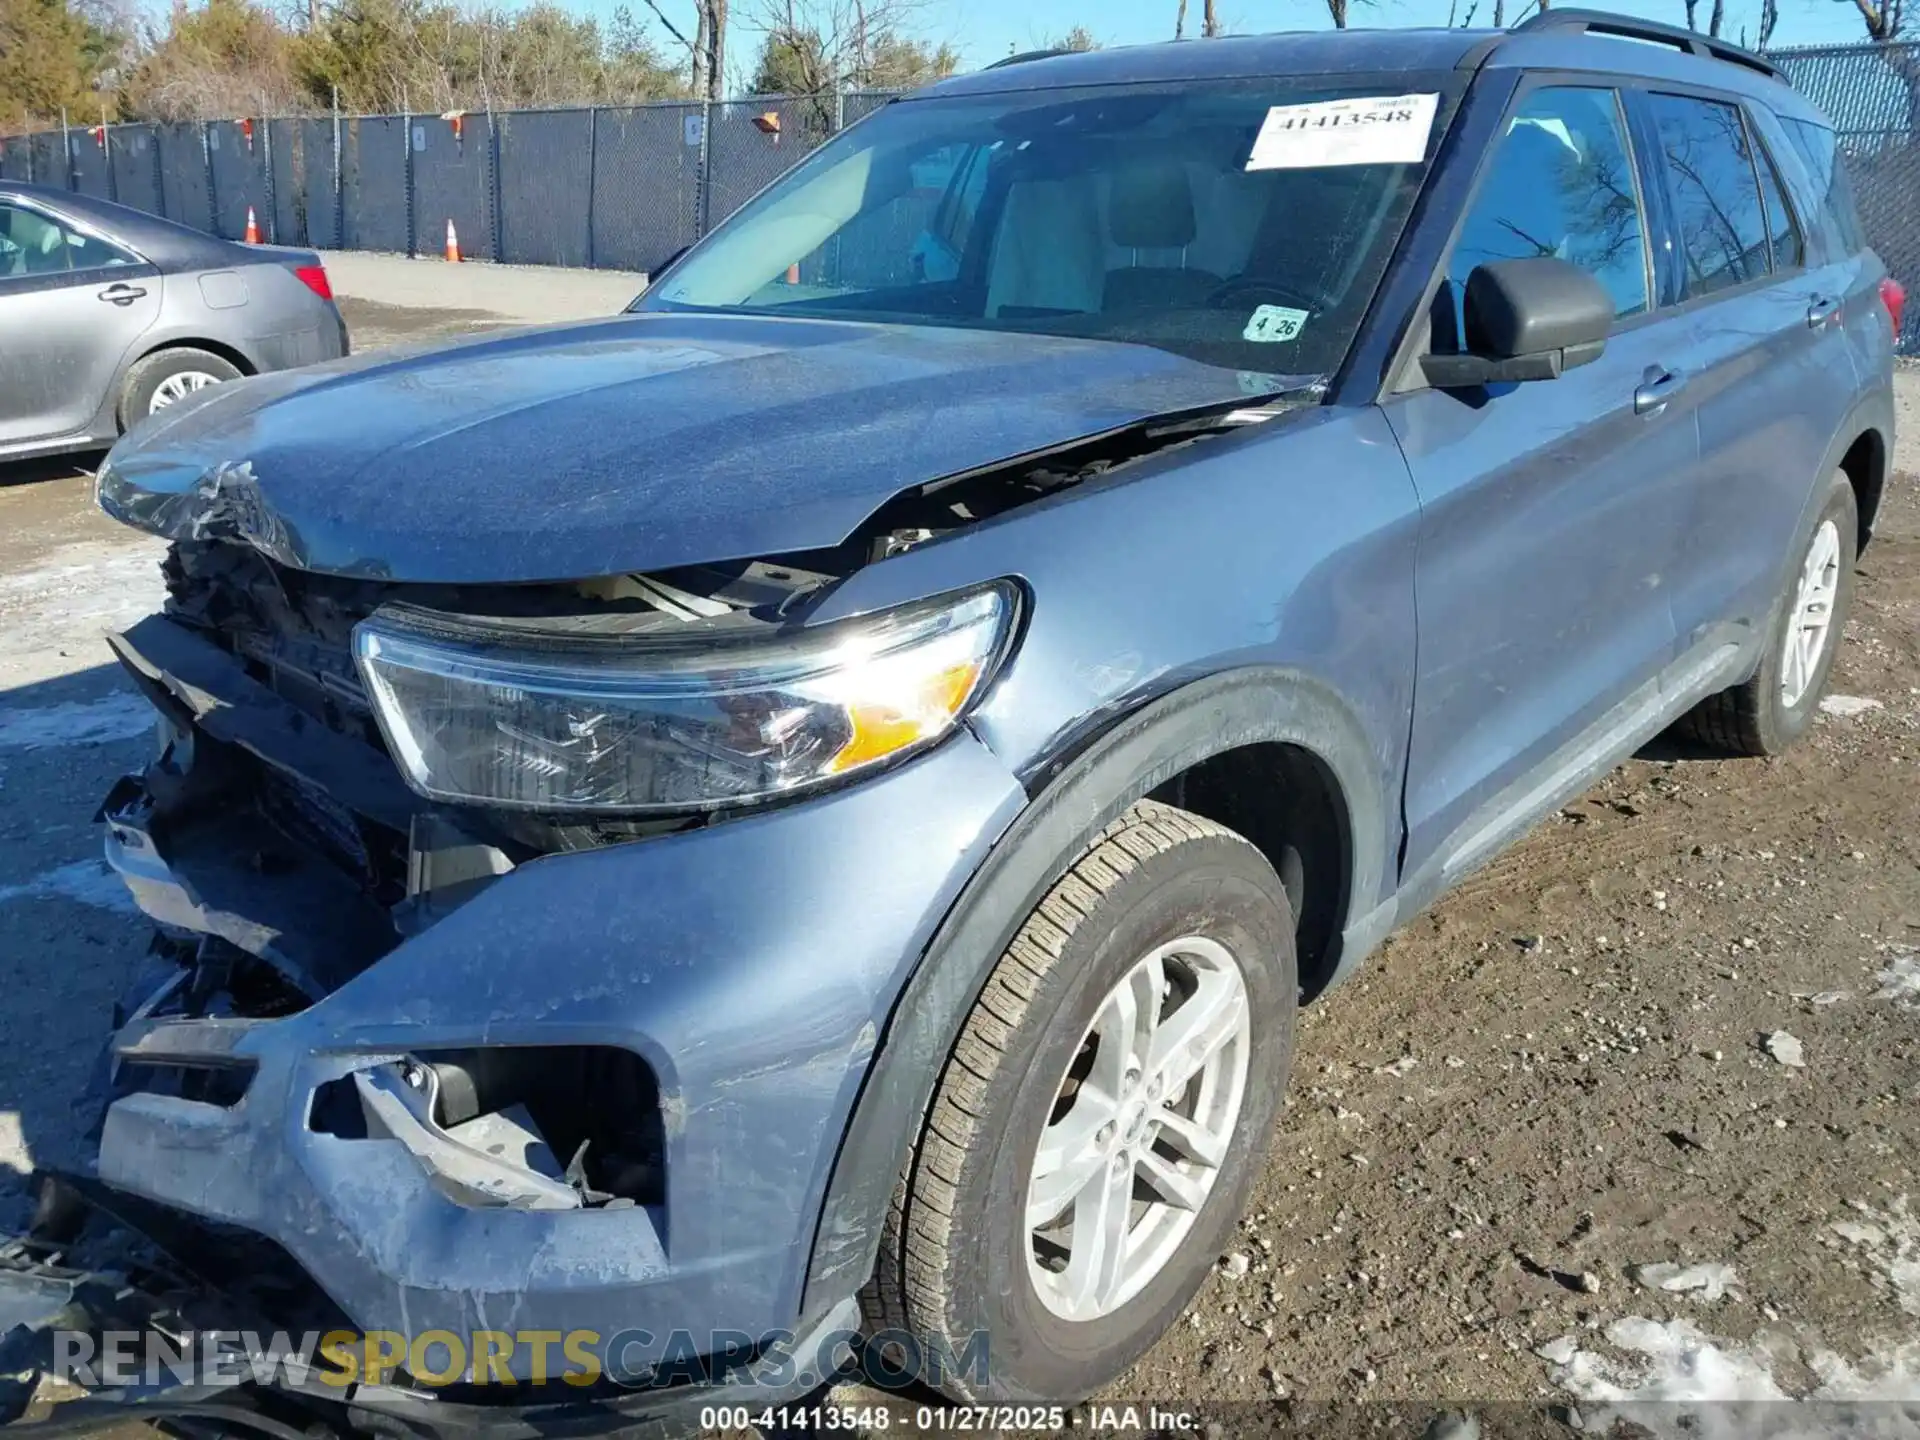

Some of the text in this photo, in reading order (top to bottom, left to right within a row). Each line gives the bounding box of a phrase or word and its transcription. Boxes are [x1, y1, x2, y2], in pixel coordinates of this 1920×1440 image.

[1279, 109, 1413, 130] 41413548
[1255, 317, 1297, 336] 4 26
